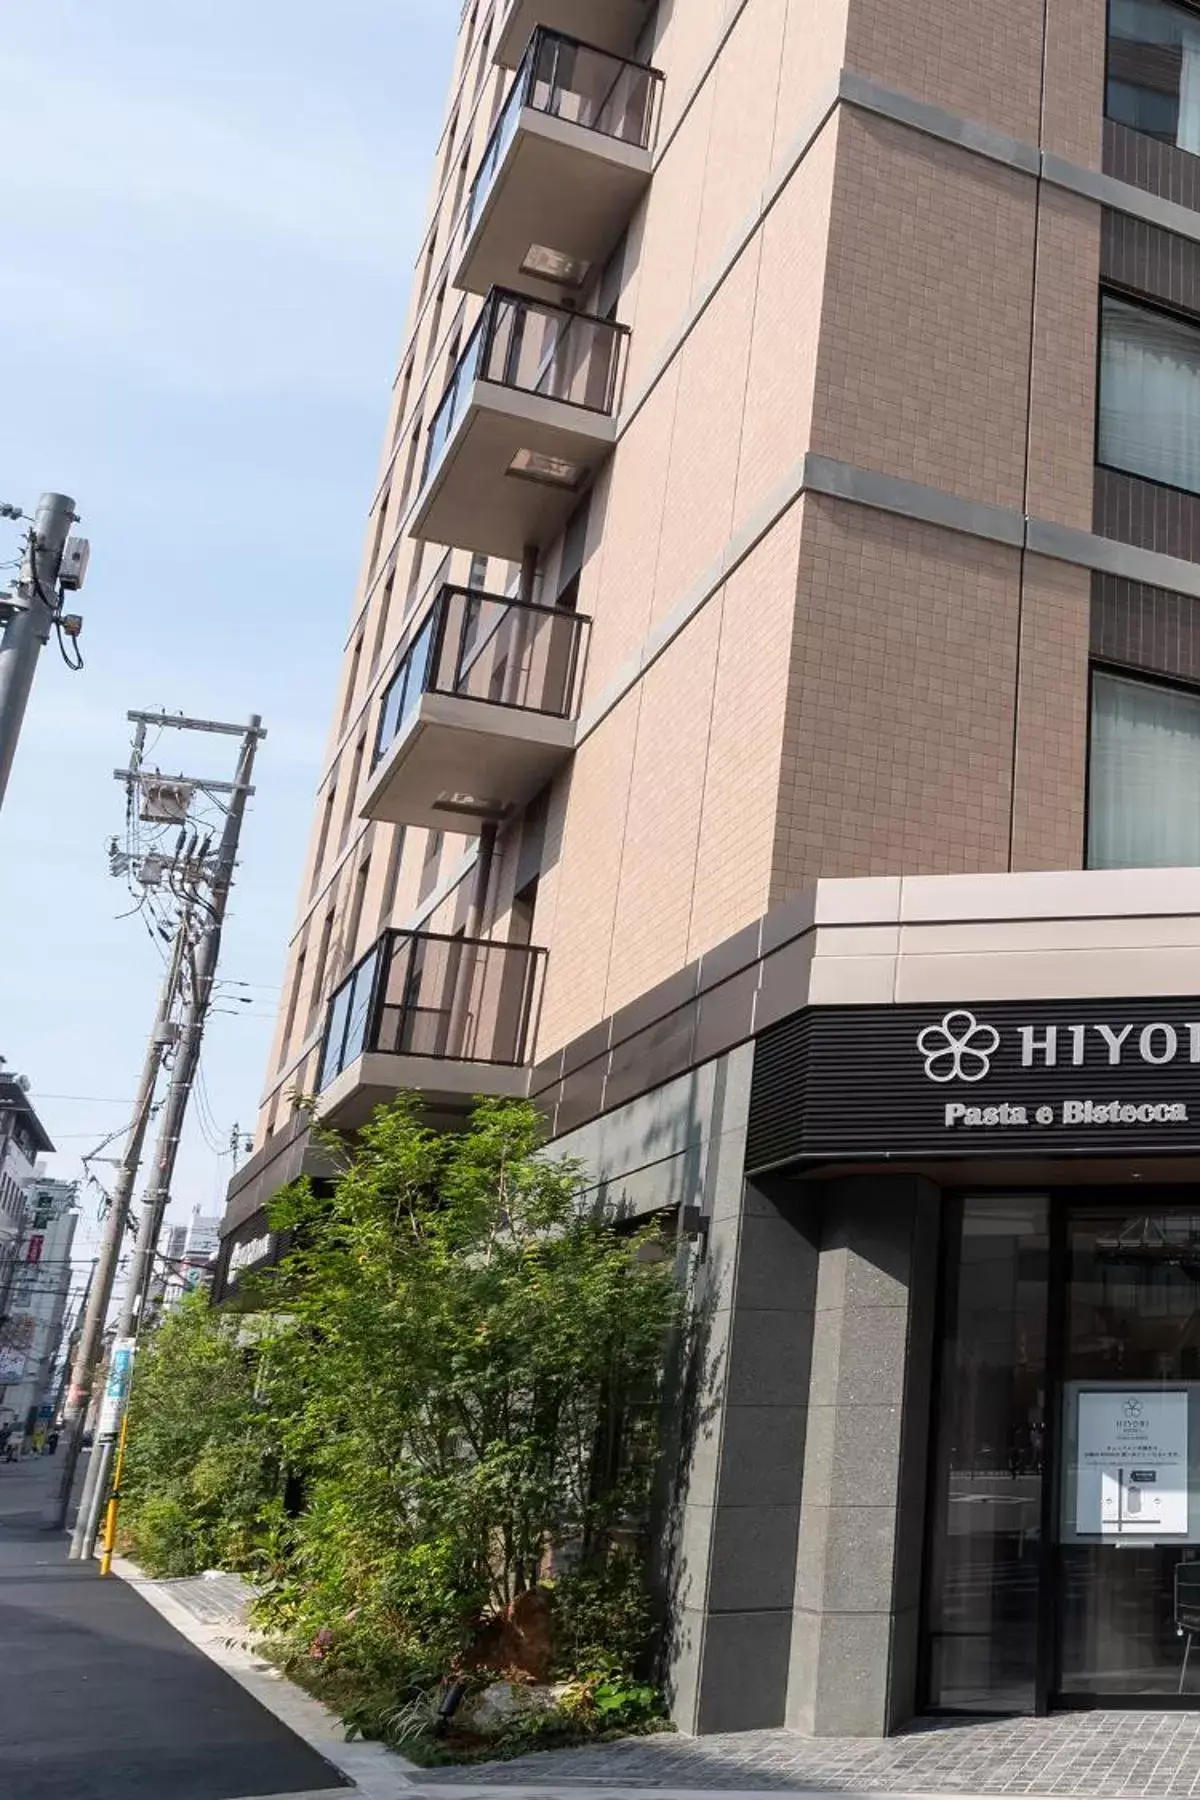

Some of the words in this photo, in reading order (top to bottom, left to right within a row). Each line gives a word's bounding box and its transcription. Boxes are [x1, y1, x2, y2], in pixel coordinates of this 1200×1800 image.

[945, 1103, 1028, 1127] Pasta
[1035, 1106, 1054, 1125] e
[1062, 1100, 1189, 1125] Bistecca
